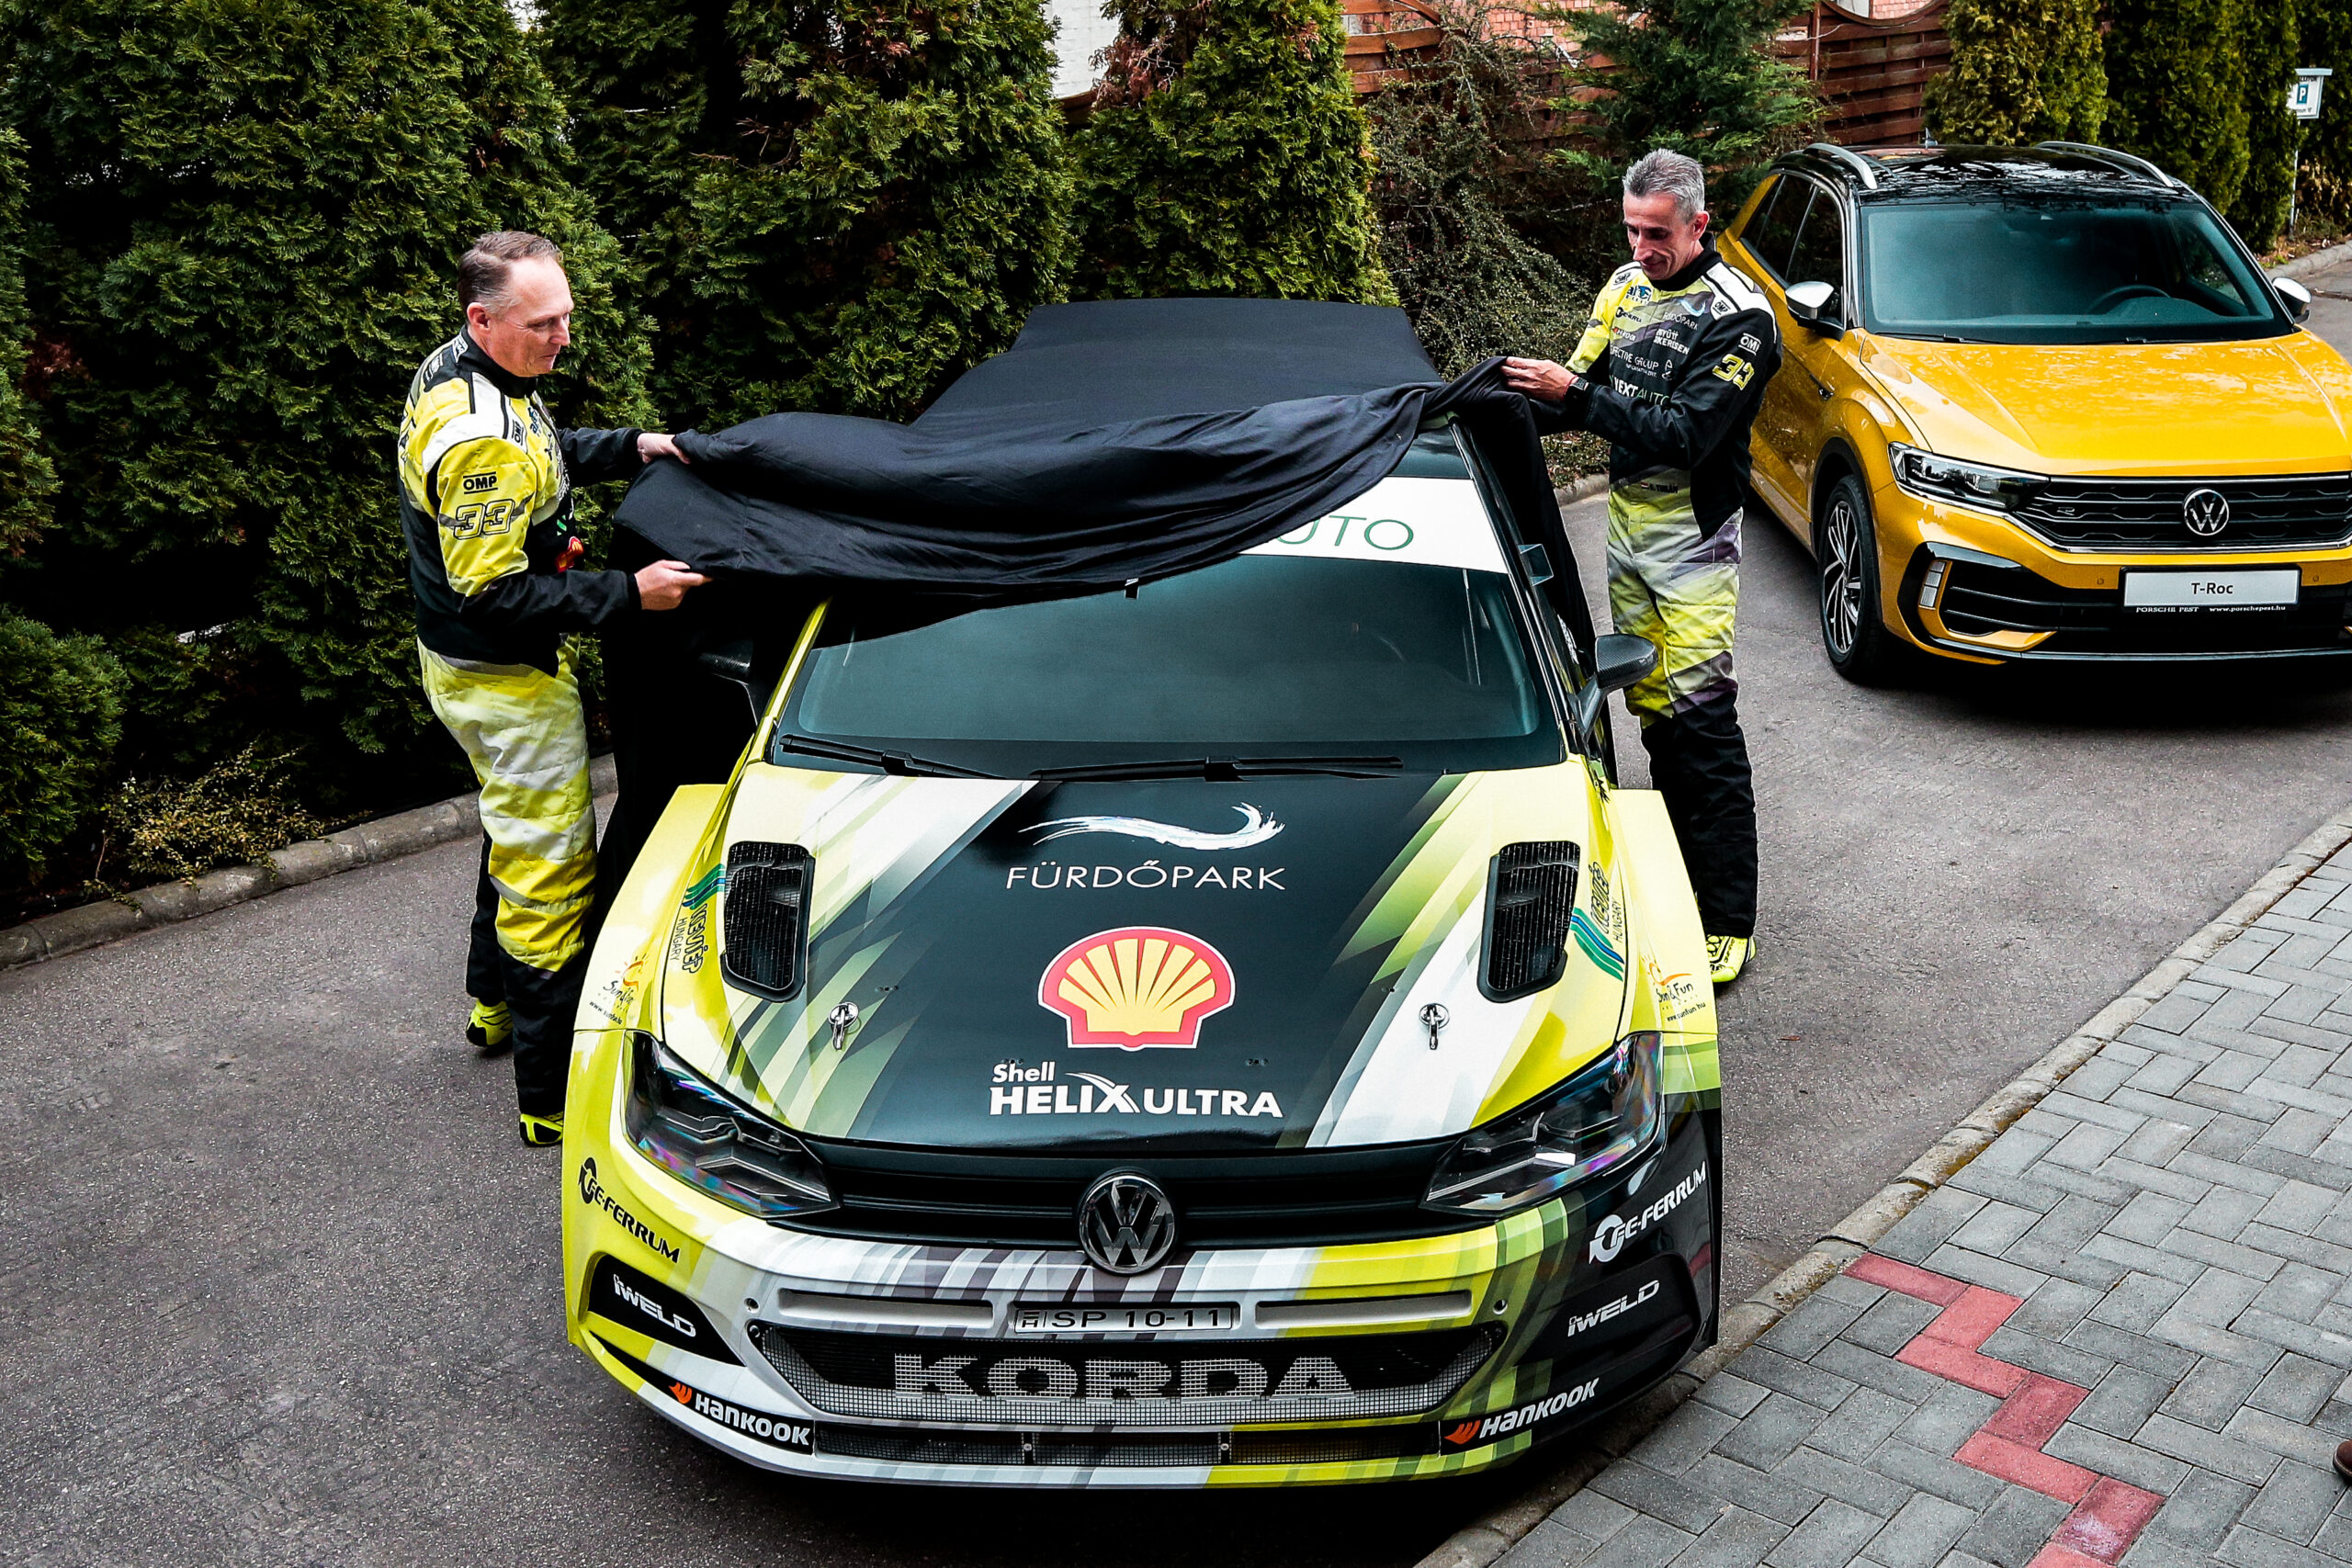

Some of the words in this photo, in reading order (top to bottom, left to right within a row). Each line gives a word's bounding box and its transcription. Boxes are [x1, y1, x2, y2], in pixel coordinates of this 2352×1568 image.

[2299, 87, 2306, 101] P
[462, 475, 498, 491] OMP
[452, 498, 515, 541] 33
[2190, 581, 2234, 595] T-Roc
[1005, 859, 1286, 890] FÜRDŐPARK
[670, 917, 688, 961] HUNGARY
[991, 1060, 1056, 1083] Shell
[989, 1075, 1140, 1116] HELIX
[1142, 1087, 1284, 1119] ULTRA
[1051, 1311, 1107, 1328] SP
[1125, 1309, 1219, 1328] 10-11
[1567, 1279, 1660, 1337] iWELD
[894, 1353, 1357, 1403] KORDA
